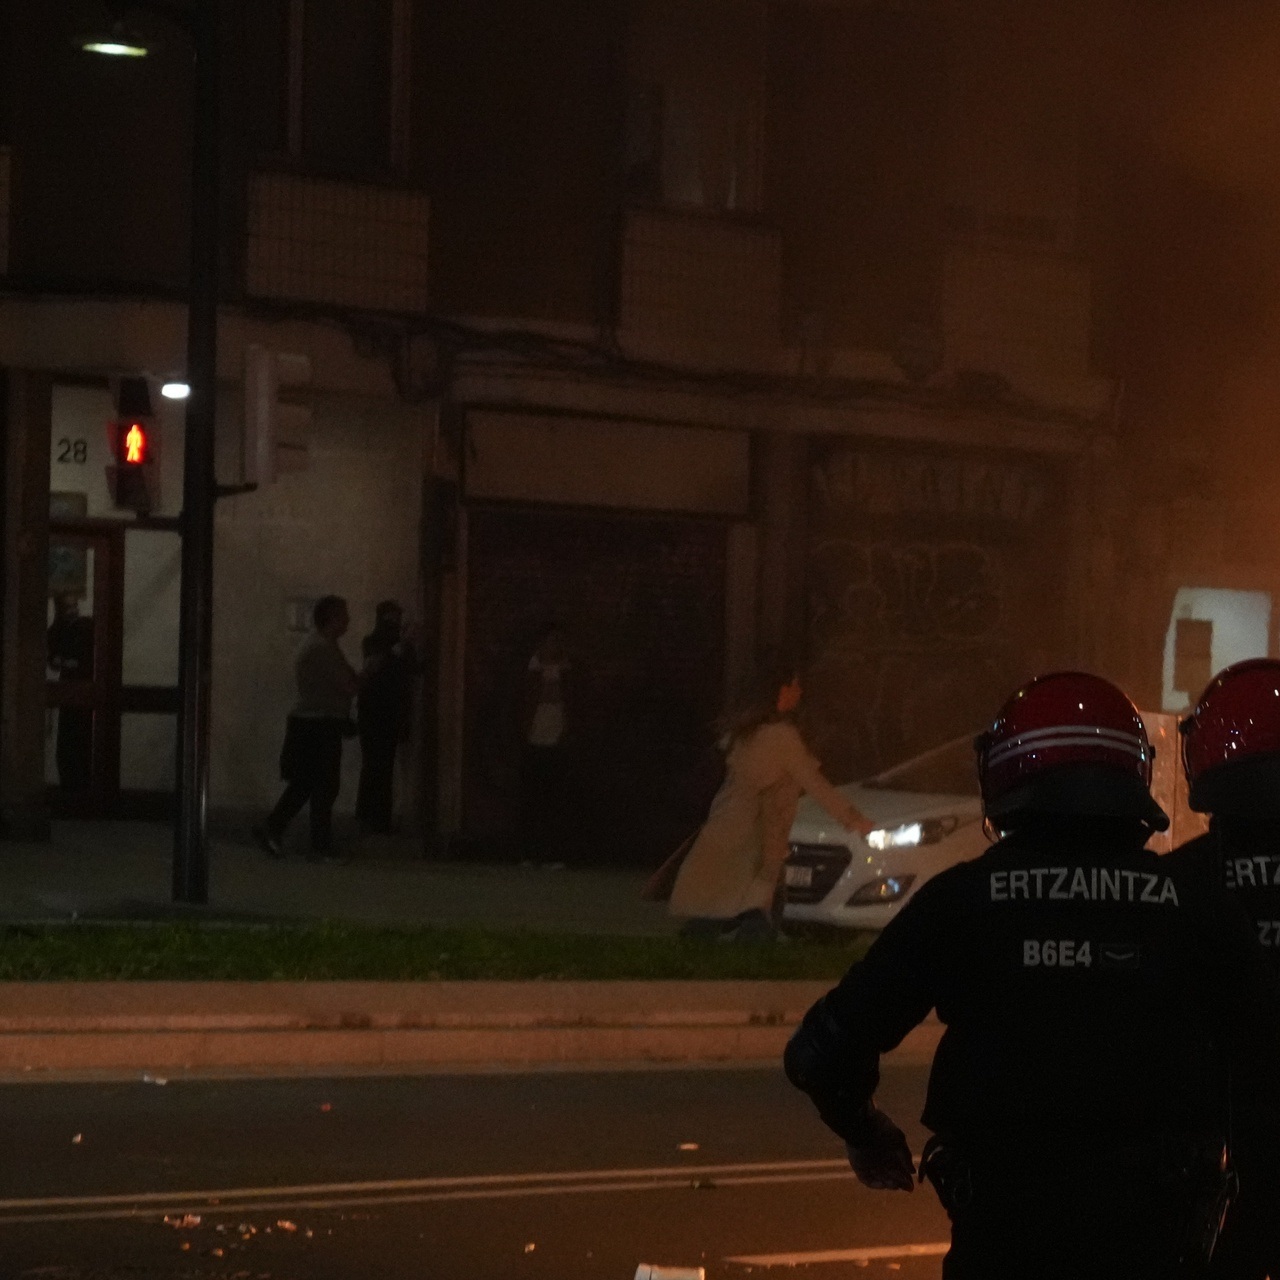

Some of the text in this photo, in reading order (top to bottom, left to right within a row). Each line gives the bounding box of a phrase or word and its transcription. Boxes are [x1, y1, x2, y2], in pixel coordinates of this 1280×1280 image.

[57, 437, 88, 464] 28
[989, 866, 1180, 908] ERTZAINTZA
[1022, 938, 1093, 969] B6E4
